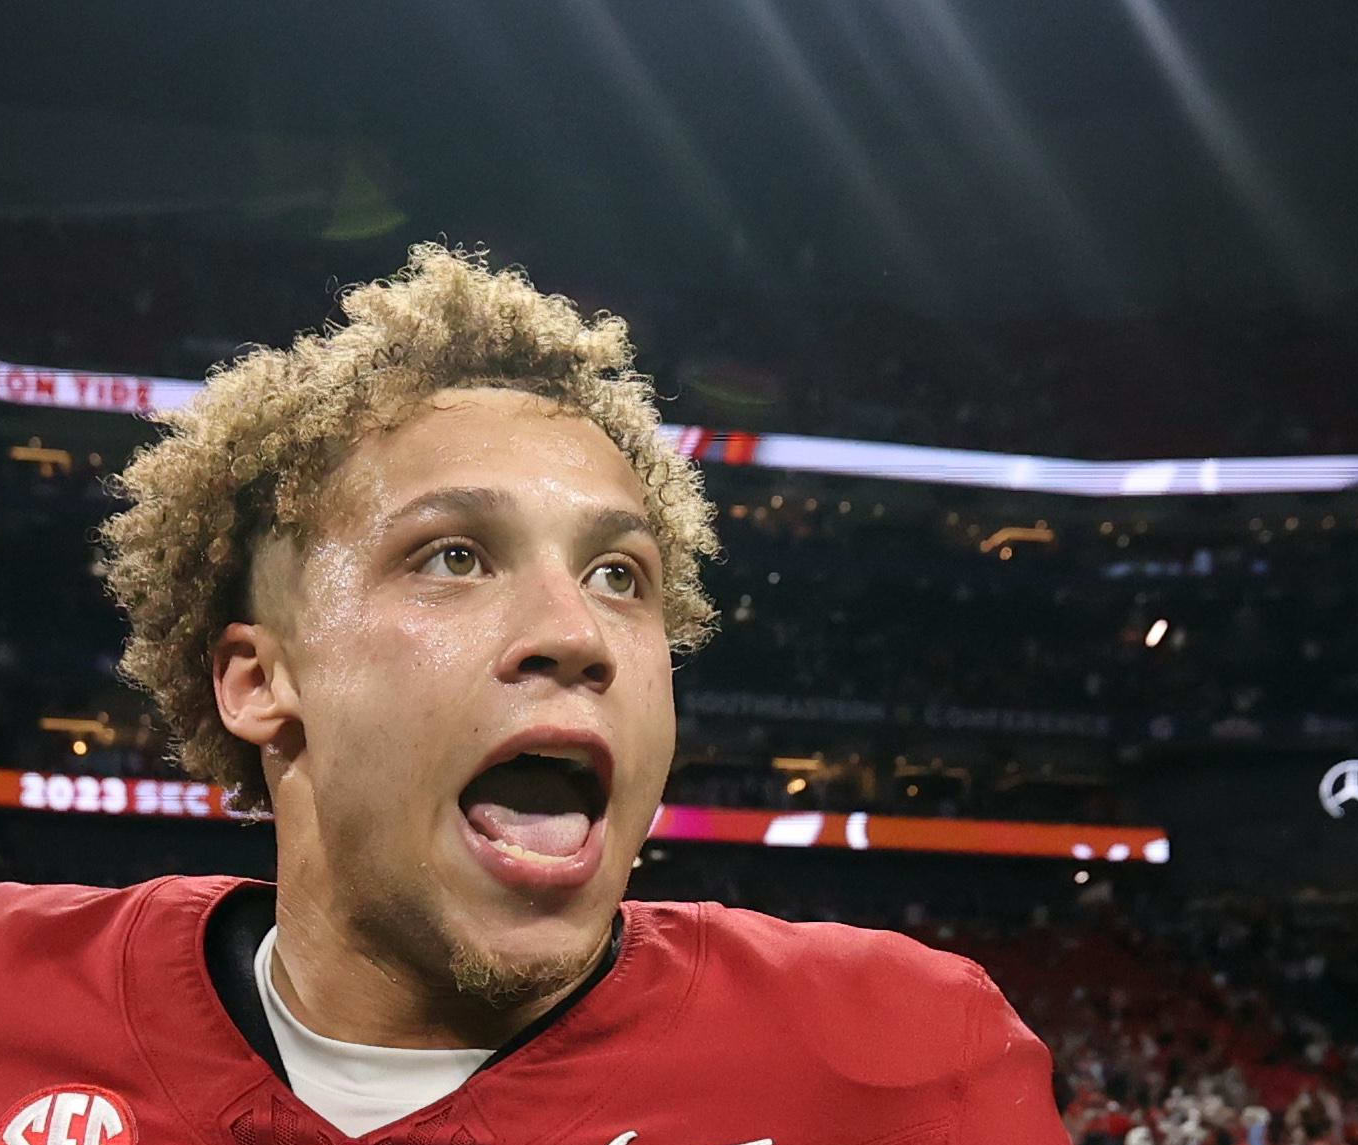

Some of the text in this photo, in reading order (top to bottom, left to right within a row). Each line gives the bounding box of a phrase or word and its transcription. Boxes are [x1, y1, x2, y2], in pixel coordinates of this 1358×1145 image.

[74, 375, 154, 412] TIDE
[19, 771, 128, 815] 2023
[135, 779, 211, 818] SEC
